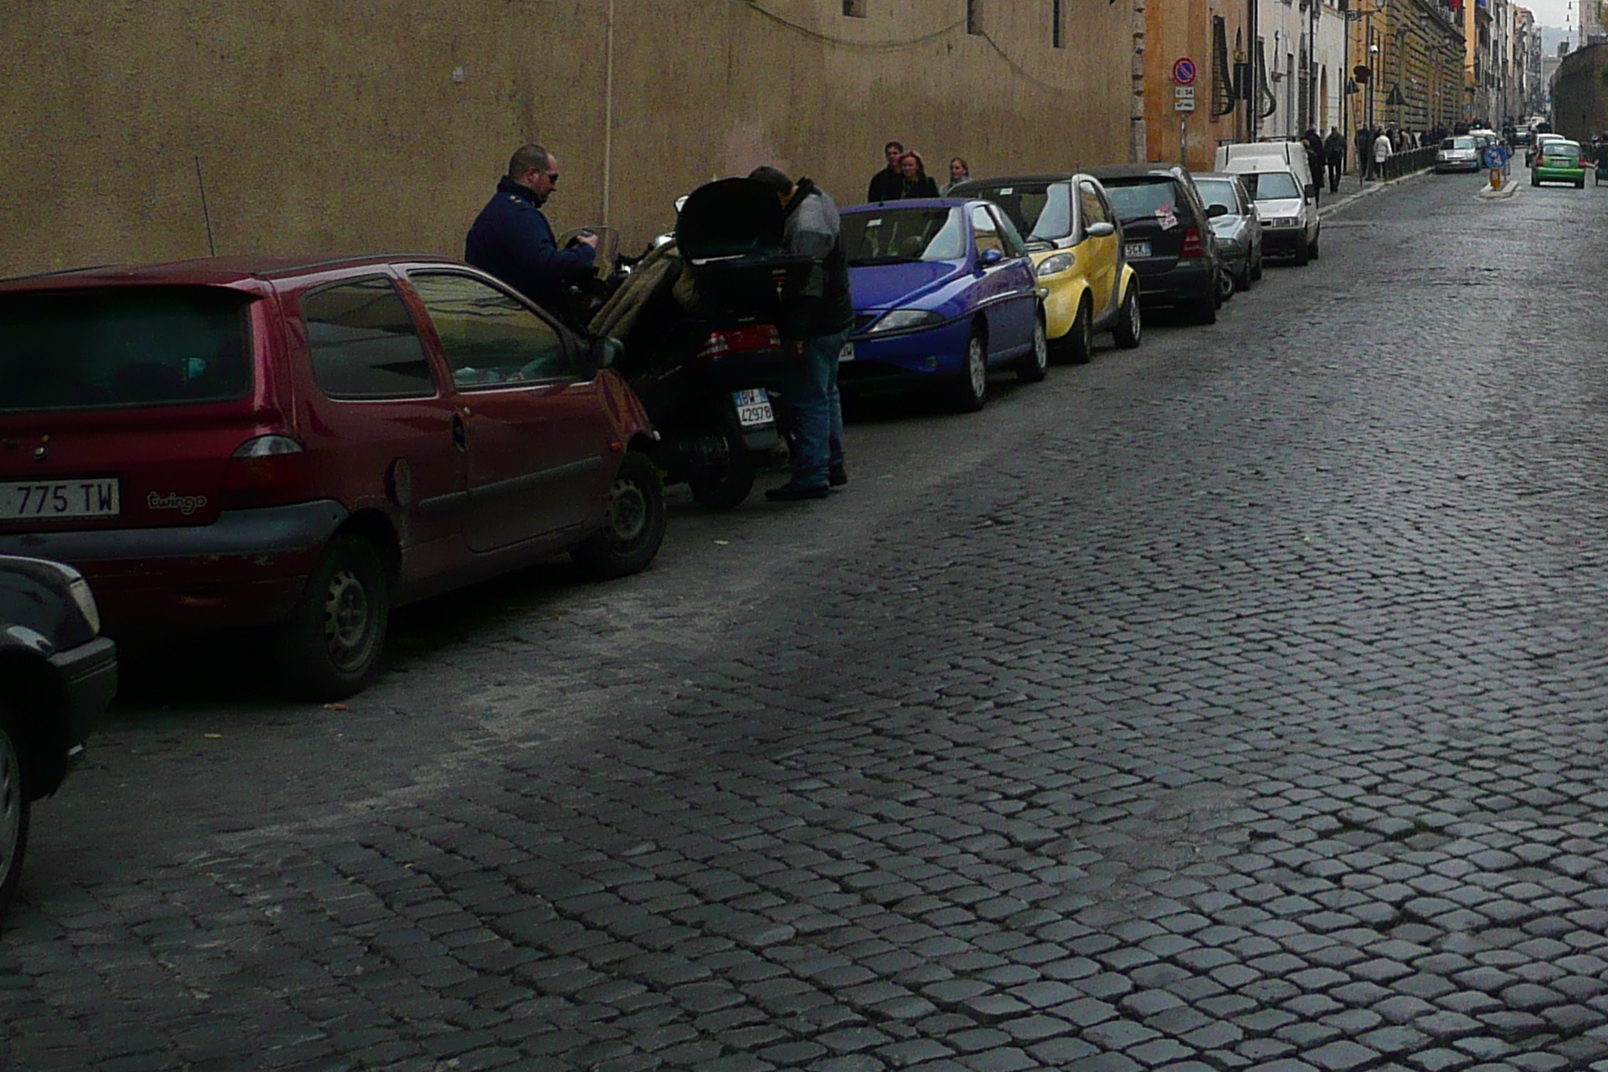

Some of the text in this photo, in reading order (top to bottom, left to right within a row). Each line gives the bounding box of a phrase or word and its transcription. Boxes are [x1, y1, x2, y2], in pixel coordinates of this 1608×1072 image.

[742, 405, 773, 422] 42978
[17, 484, 112, 515] 775 TW
[147, 490, 207, 516] twingo
